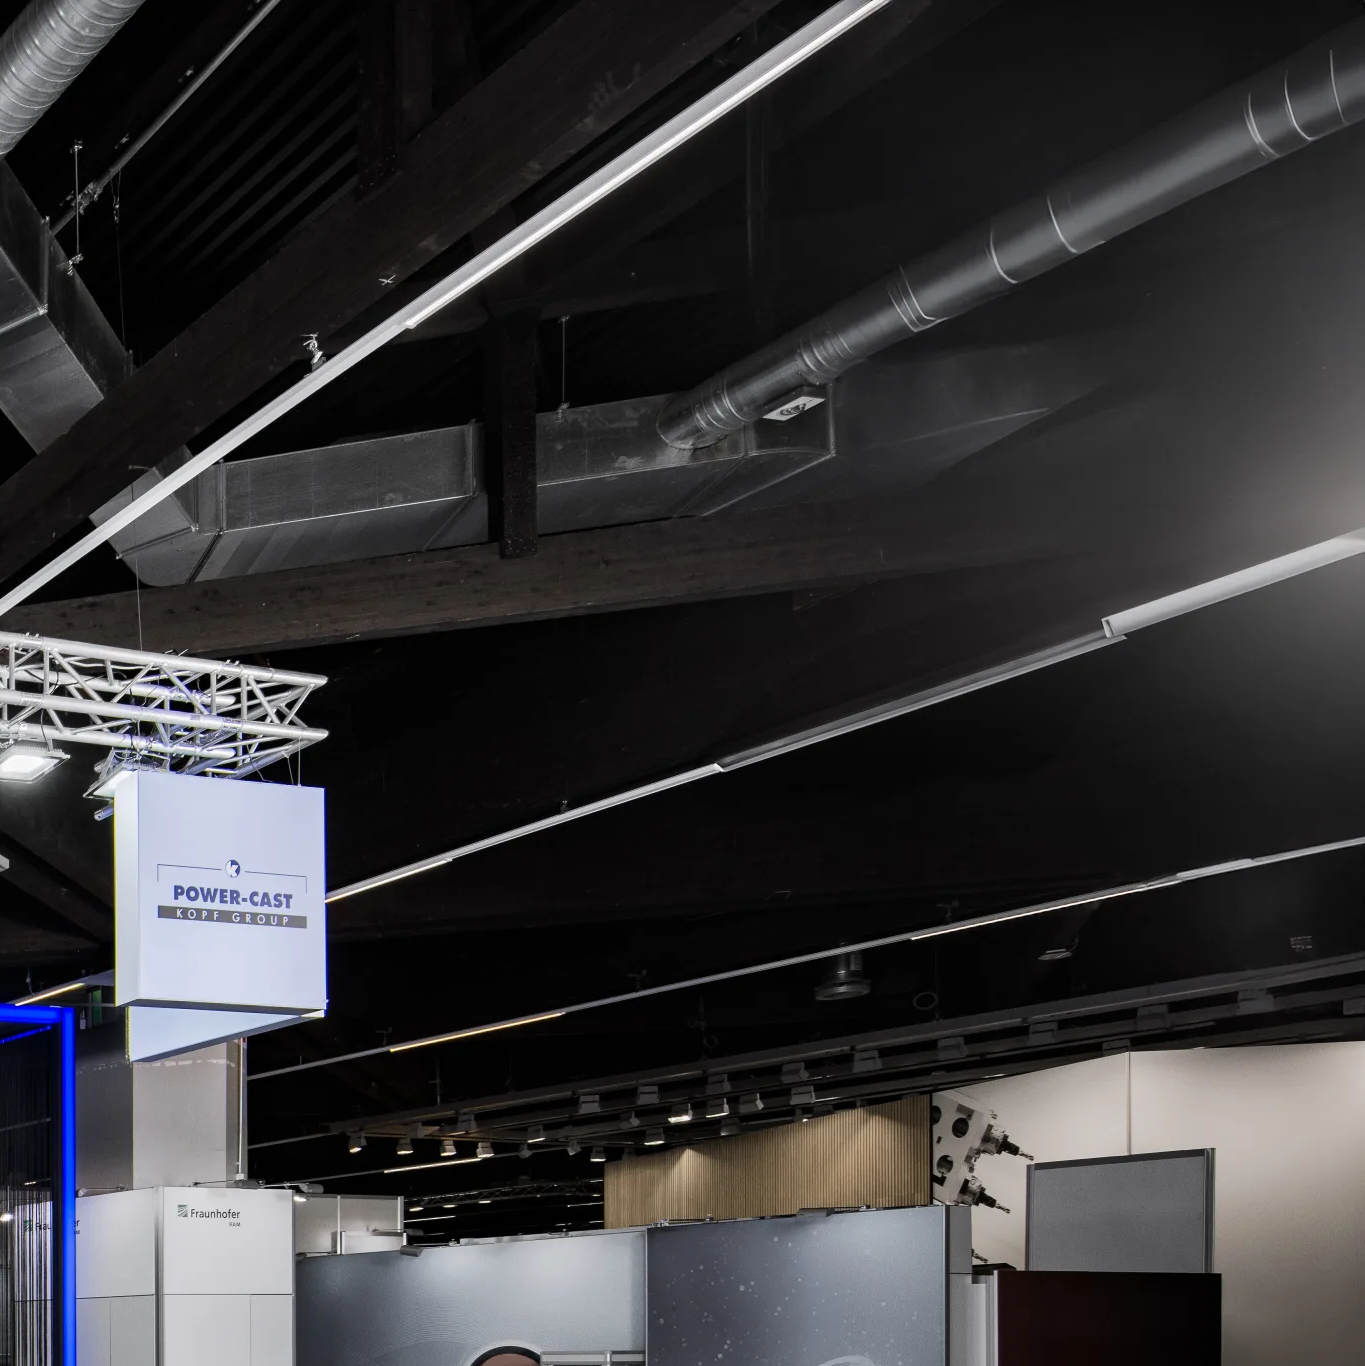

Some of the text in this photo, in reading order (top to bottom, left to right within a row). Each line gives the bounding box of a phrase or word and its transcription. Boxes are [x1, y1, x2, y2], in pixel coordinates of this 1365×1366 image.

[173, 885, 293, 909] POWER-CAST
[176, 908, 289, 926] KOPF GROUP
[190, 1208, 241, 1219] Fraunhofer
